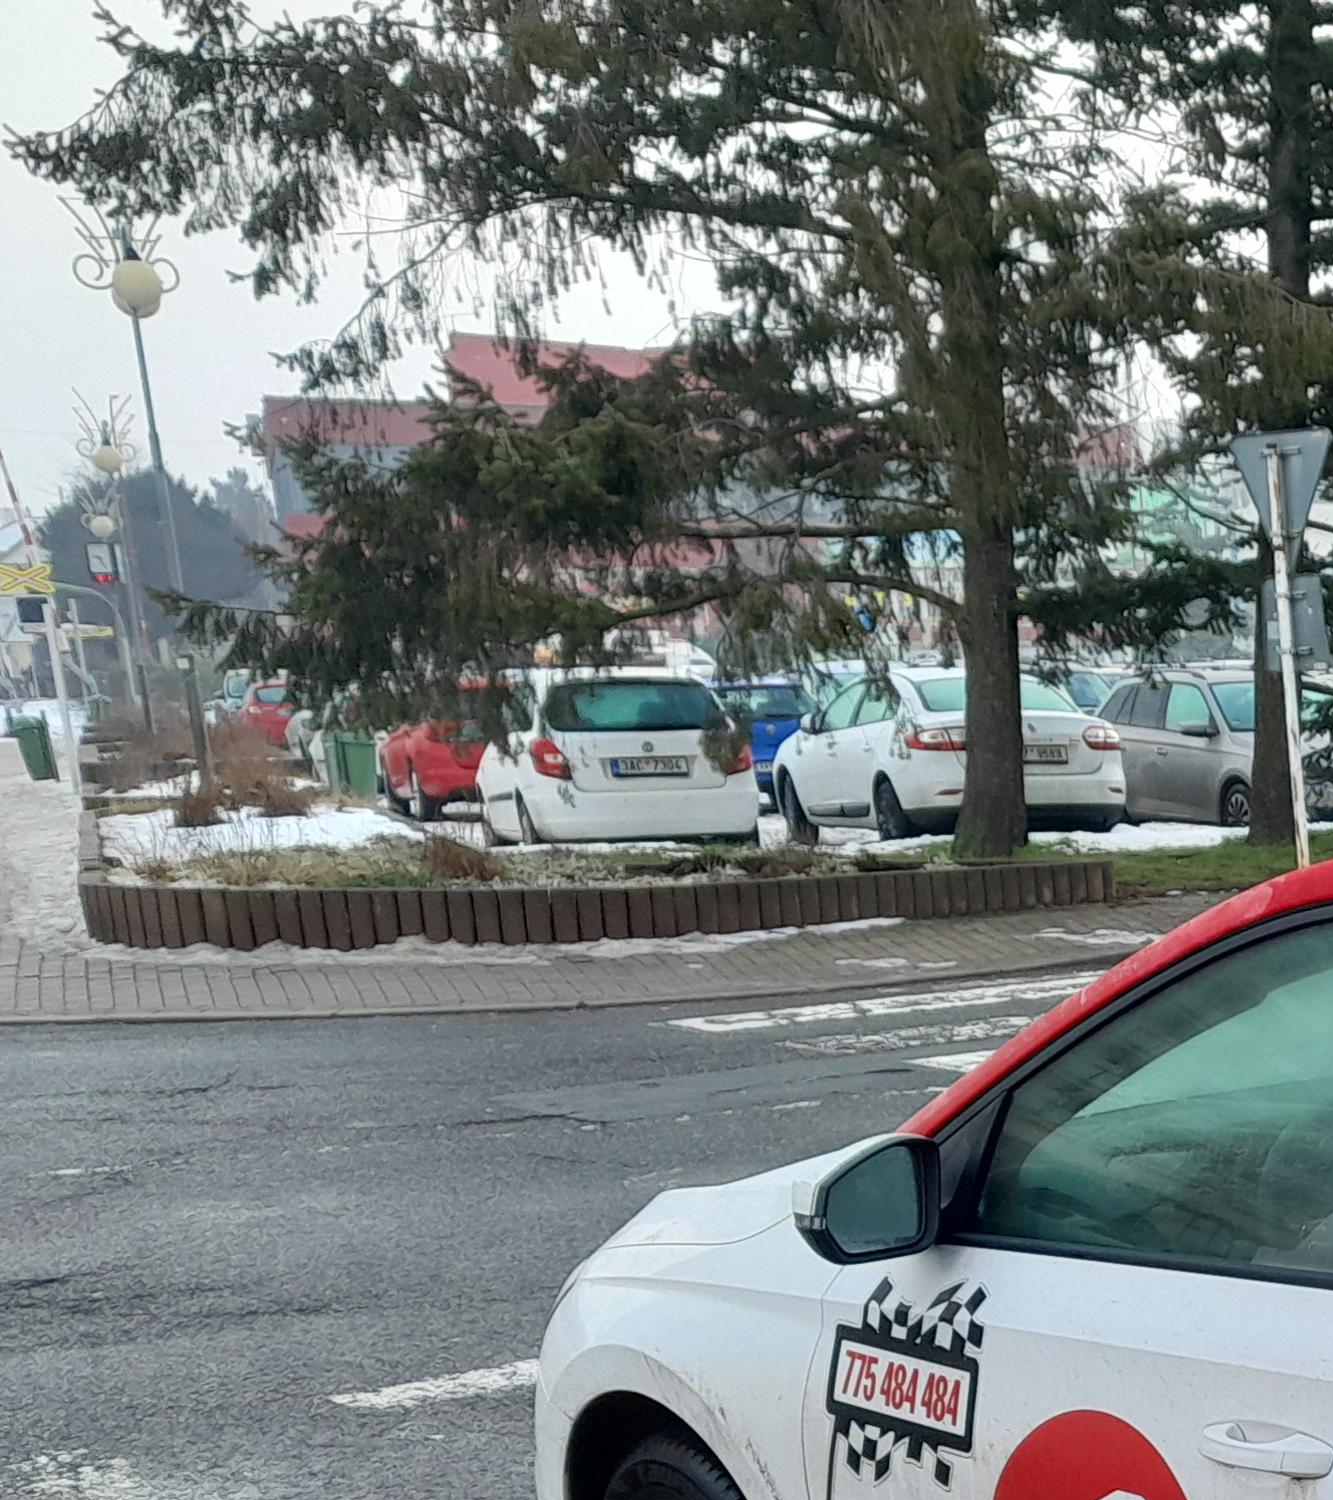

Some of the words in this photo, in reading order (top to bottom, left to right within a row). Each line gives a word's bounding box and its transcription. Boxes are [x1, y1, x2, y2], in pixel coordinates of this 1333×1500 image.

[842, 1350, 879, 1402] 775
[880, 1361, 919, 1414] 484
[920, 1372, 961, 1427] 484
